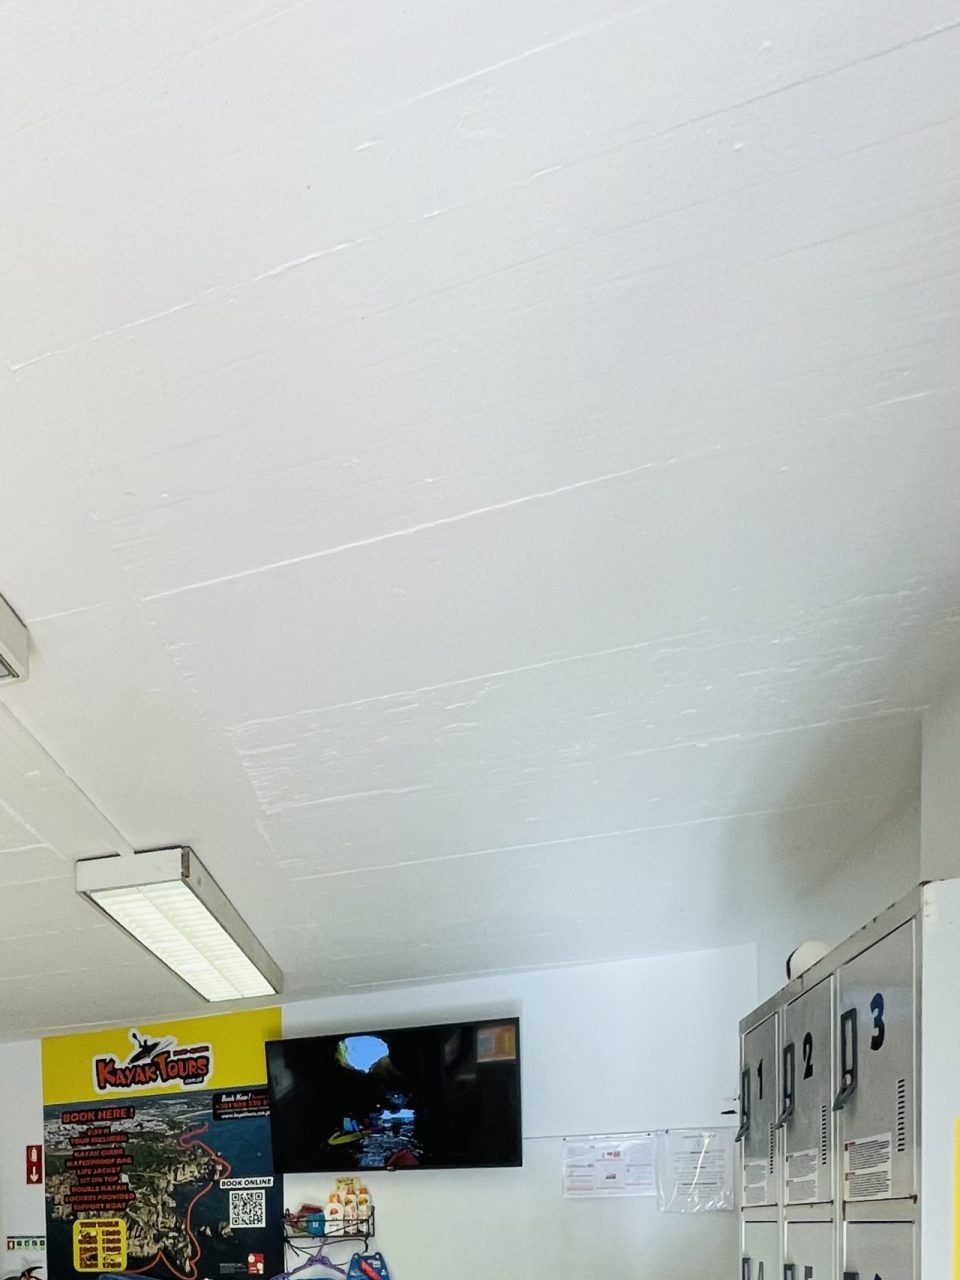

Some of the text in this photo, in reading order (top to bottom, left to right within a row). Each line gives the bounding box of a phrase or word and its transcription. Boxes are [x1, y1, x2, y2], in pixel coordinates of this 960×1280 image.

[870, 993, 886, 1051] 3
[756, 1058, 764, 1100] 1
[802, 1037, 814, 1080] 2
[63, 1111, 95, 1123] BOOK
[98, 1108, 127, 1120] HERE
[221, 1178, 272, 1188] BOOK ONLINE
